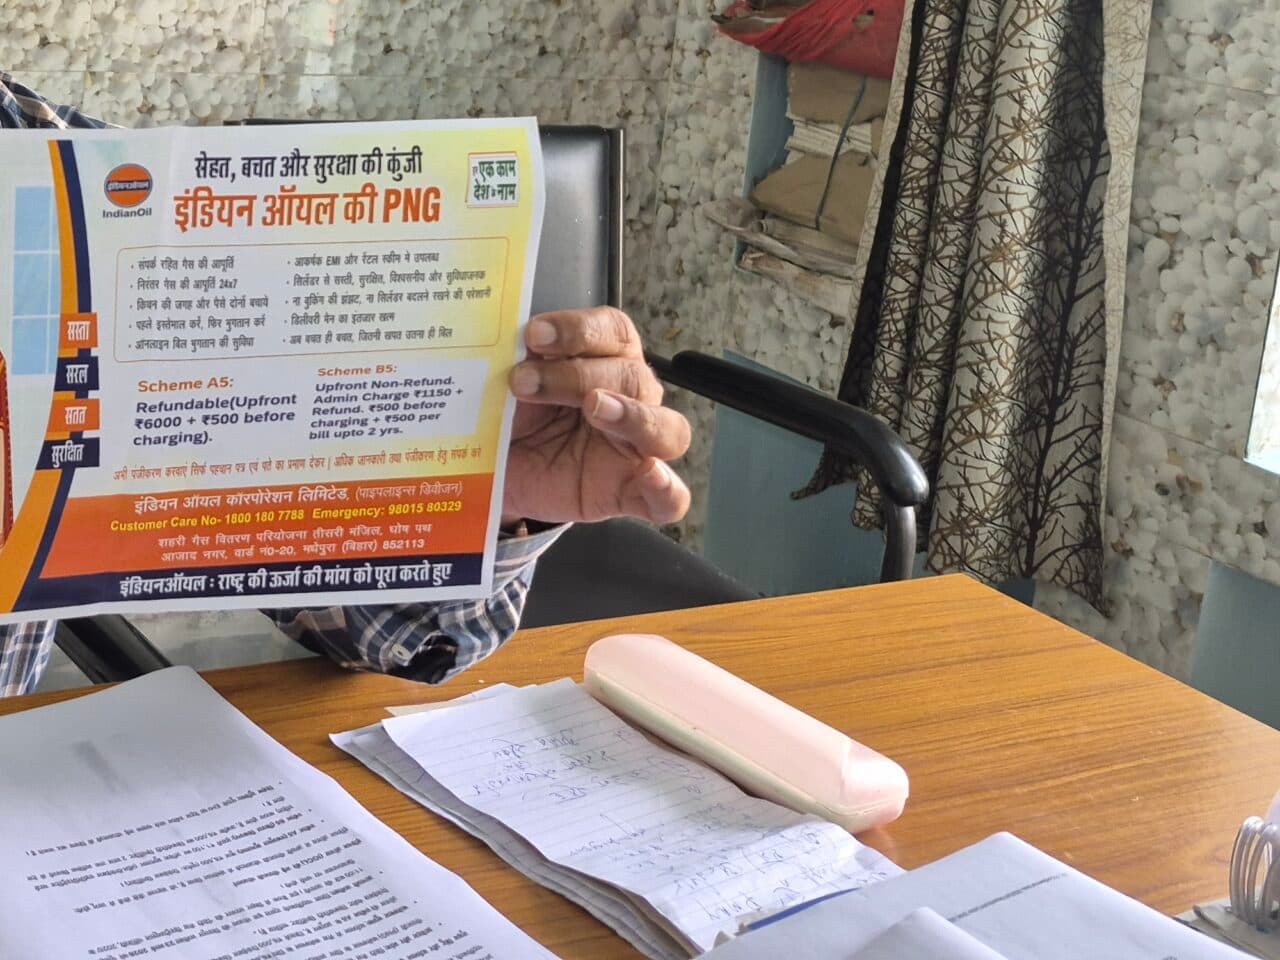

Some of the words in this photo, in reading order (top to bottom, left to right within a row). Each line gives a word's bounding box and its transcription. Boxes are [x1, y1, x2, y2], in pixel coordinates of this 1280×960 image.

[194, 151, 236, 182] सेहत,
[241, 156, 276, 178] बचत
[280, 148, 311, 177] और
[313, 154, 358, 183] सुरक्षा
[361, 147, 383, 175] की
[386, 145, 423, 181] कुंजी
[478, 161, 494, 182] एक
[496, 160, 516, 177] काम
[474, 178, 490, 200] देश
[497, 184, 517, 200] नाम
[102, 208, 152, 218] IndianOil
[173, 186, 257, 233] इंडियन
[261, 185, 339, 227] ऑयल
[343, 182, 378, 224] की
[383, 186, 441, 223] PNG
[160, 257, 178, 271] रहित
[182, 257, 194, 270] गैस
[198, 256, 208, 269] की
[326, 255, 341, 266] EMI
[344, 252, 358, 265] और
[164, 277, 176, 290] गैस
[180, 277, 190, 290] की
[219, 279, 238, 289] 24x7
[323, 273, 330, 285] से
[429, 268, 442, 281] और
[161, 297, 171, 310] की
[196, 297, 210, 309] और
[327, 292, 337, 305] की
[338, 314, 348, 324] का
[67, 321, 91, 341] सस्ता
[172, 337, 187, 349] बिल
[219, 335, 229, 347] की
[65, 364, 89, 384] सरल
[318, 366, 371, 376] Scheme
[375, 364, 398, 374] B5:
[138, 379, 203, 392] Scheme
[207, 376, 235, 389] A5:
[315, 381, 367, 393] Upfront
[371, 376, 455, 389] Non-Refund.
[136, 394, 297, 414] Refundable(Upfront
[313, 394, 358, 404] Admin
[362, 392, 410, 402] Charge
[414, 388, 452, 398] ₹1150
[64, 406, 87, 425] सतत
[312, 405, 364, 416] Refund.
[369, 403, 400, 413] ₹500
[403, 400, 447, 410] before
[134, 416, 182, 430] ₹6000
[187, 416, 197, 425] +
[201, 413, 239, 426] ₹500
[244, 411, 296, 423] before
[310, 416, 369, 428] charging
[385, 413, 415, 423] ₹500
[418, 412, 441, 423] per
[133, 431, 213, 446] charging).
[309, 430, 330, 440] bill
[333, 429, 365, 440] upto
[367, 427, 376, 436] 2
[379, 426, 403, 437] yrs.
[51, 440, 84, 468] सुरक्षित
[134, 496, 178, 514] इंडियन
[182, 493, 221, 510] ऑयल
[110, 519, 168, 531] Customer
[170, 516, 198, 528] Care
[201, 514, 222, 526] No-
[225, 513, 251, 525] 1800
[255, 511, 275, 523] 180
[278, 509, 304, 521] 7788
[312, 506, 386, 520] Emergency:
[388, 503, 424, 515] 98015
[426, 500, 462, 513] 80329
[158, 534, 186, 548] शहरी
[191, 533, 209, 546] गैस
[215, 531, 251, 546] वितरण
[256, 527, 307, 542] परियोजना
[312, 524, 344, 540] तीसरी
[161, 550, 197, 562] आजाद
[234, 544, 255, 558] वार्ड
[303, 542, 337, 556] मधेपुरा
[342, 540, 378, 553] (बिहार)
[383, 538, 425, 550] 852113
[120, 572, 207, 597] इंडियनऑयल
[218, 573, 245, 593] राष्ट्र
[247, 568, 267, 589] की
[269, 565, 301, 588] ऊर्जा
[303, 565, 323, 587] की
[324, 564, 351, 585] मांग
[354, 562, 373, 583] को
[375, 565, 398, 588] पूरा
[400, 560, 431, 580] करते
[433, 563, 453, 585] हुए
